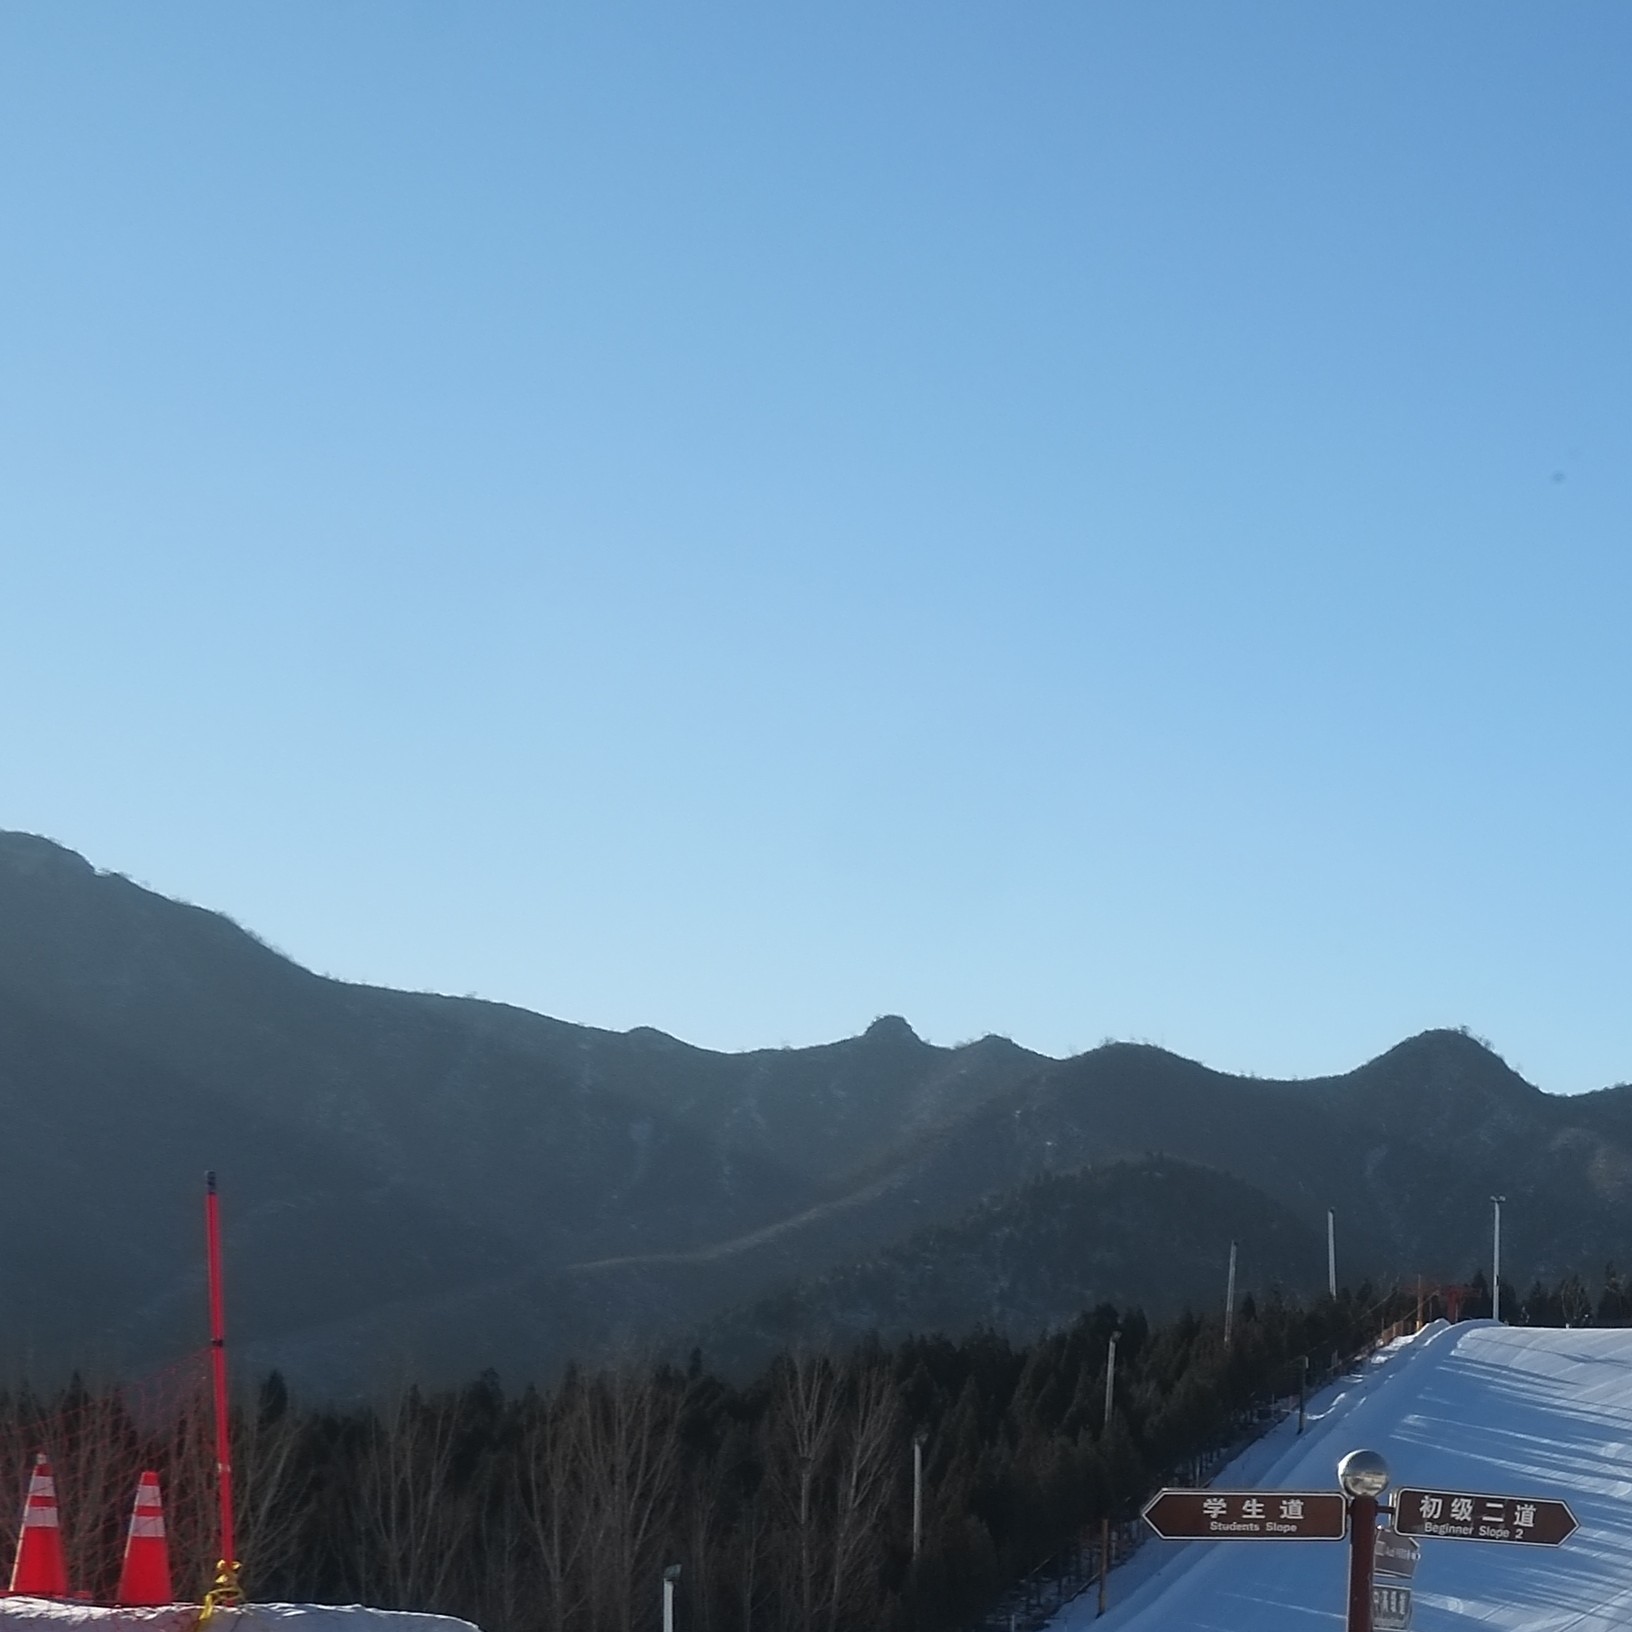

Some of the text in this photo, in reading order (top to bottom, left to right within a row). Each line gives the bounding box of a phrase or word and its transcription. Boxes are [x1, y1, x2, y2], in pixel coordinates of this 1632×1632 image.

[1203, 1498, 1304, 1519] 学生道
[1419, 1495, 1537, 1528] 初级二道
[1210, 1521, 1298, 1533] Students Slope
[1424, 1522, 1524, 1539] Beginner Slope 2
